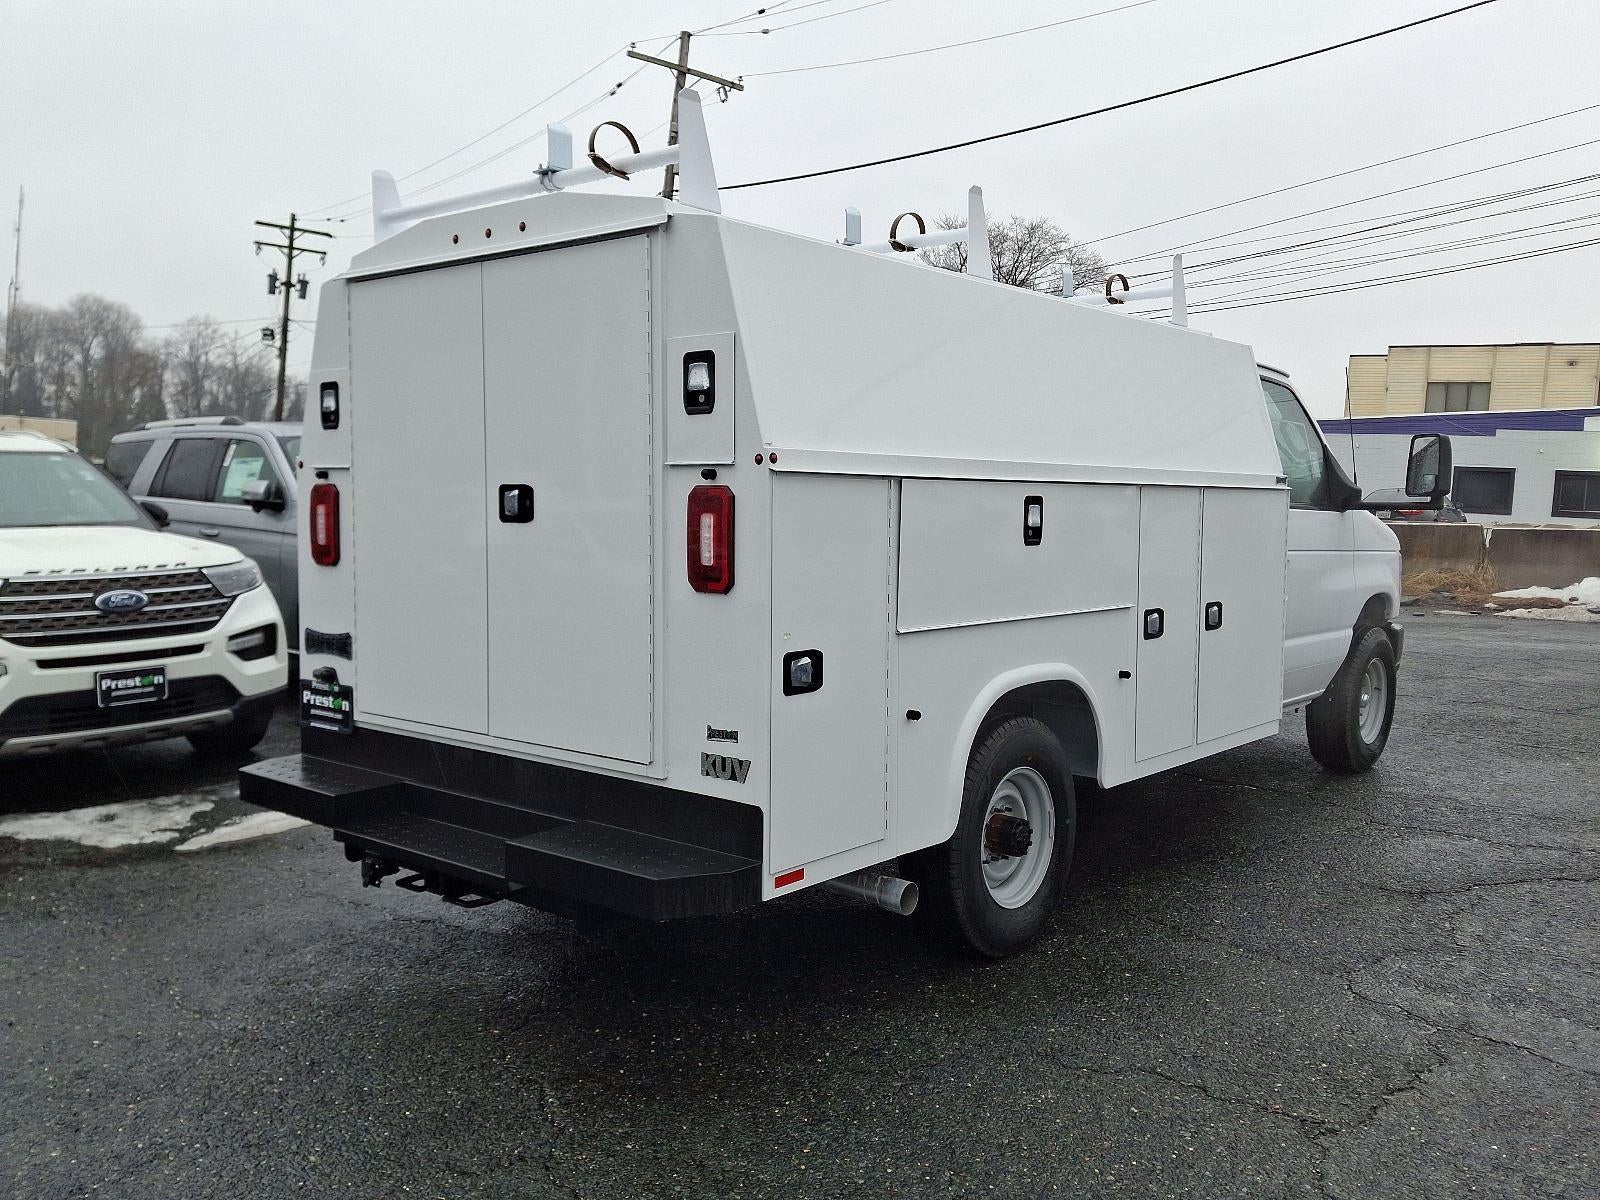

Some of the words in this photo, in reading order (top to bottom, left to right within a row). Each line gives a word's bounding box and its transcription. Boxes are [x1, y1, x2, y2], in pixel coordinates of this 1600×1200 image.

[101, 674, 164, 691] Preston
[303, 690, 349, 711] Preston
[701, 752, 751, 783] KUV
